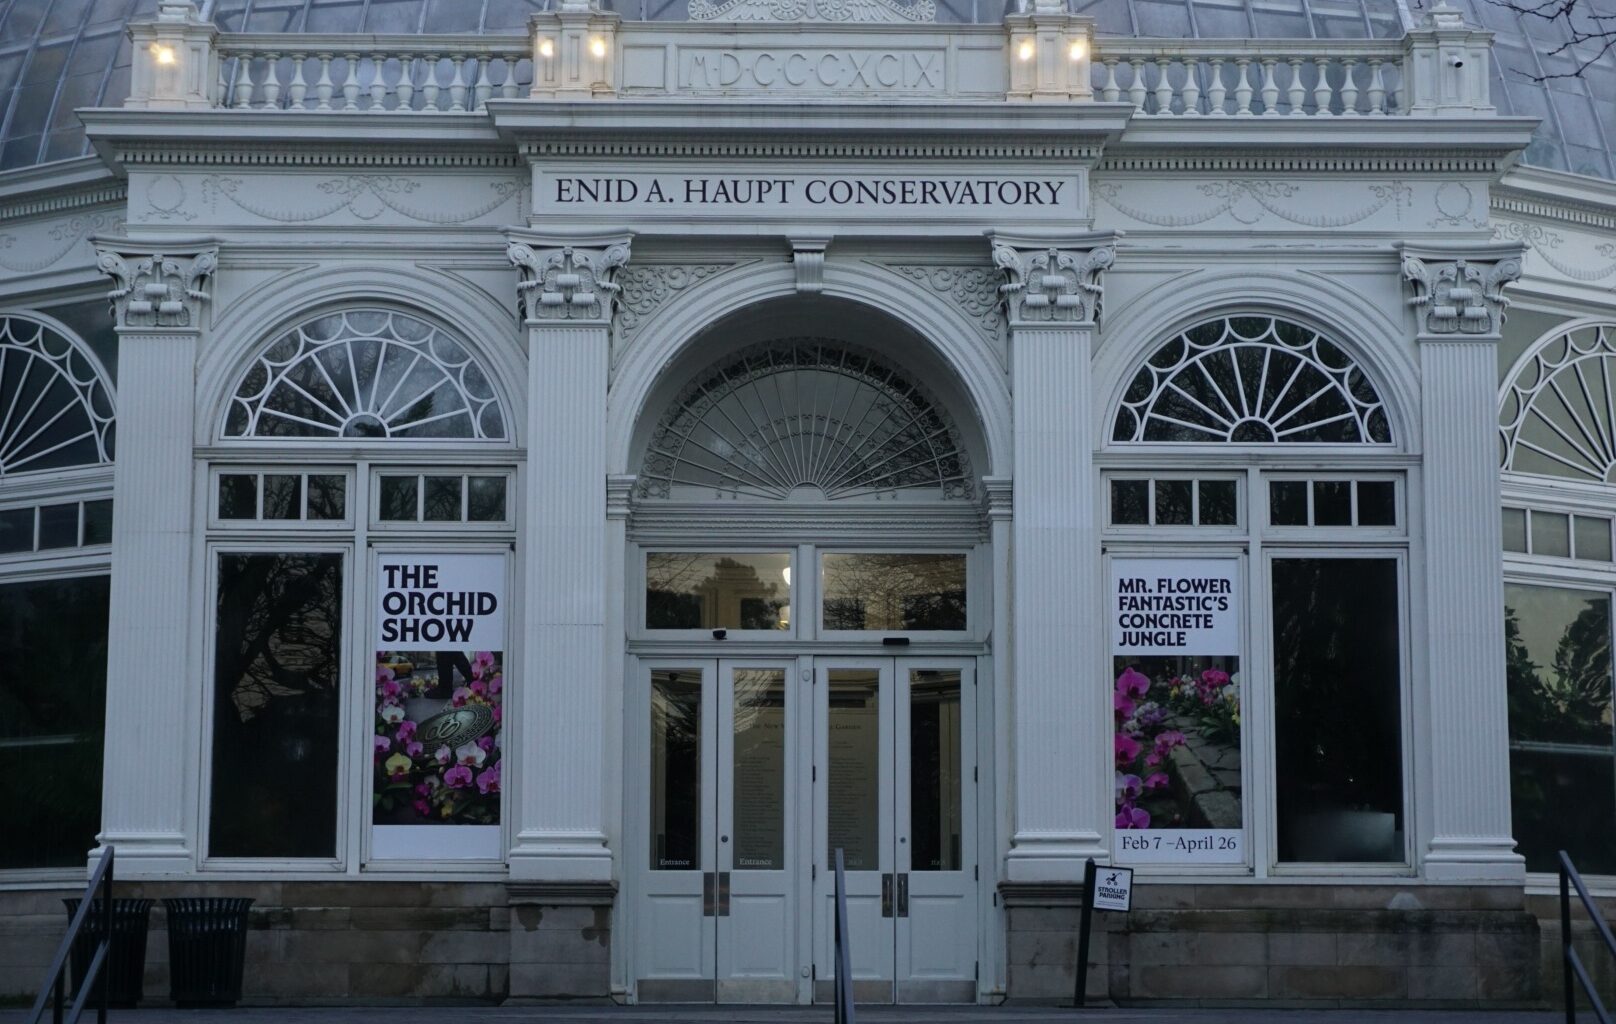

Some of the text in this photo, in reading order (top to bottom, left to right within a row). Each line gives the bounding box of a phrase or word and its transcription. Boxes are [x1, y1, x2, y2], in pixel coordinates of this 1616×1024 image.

[556, 178, 1065, 205] ENID A. HAUPT CONSERVATORY
[383, 565, 439, 589] THE
[1118, 578, 1231, 594] MR. FLOWER
[382, 592, 498, 616] ORCHID
[1118, 613, 1214, 629] CONCRETE
[381, 618, 474, 643] SHOW
[1118, 631, 1187, 647] JUNGLE
[1122, 836, 1150, 849] Feb
[1153, 837, 1162, 849] 7
[1218, 837, 1237, 849] 26
[660, 858, 690, 866] Entrance
[739, 858, 772, 866] Entrance
[1098, 887, 1127, 895] STROLLER
